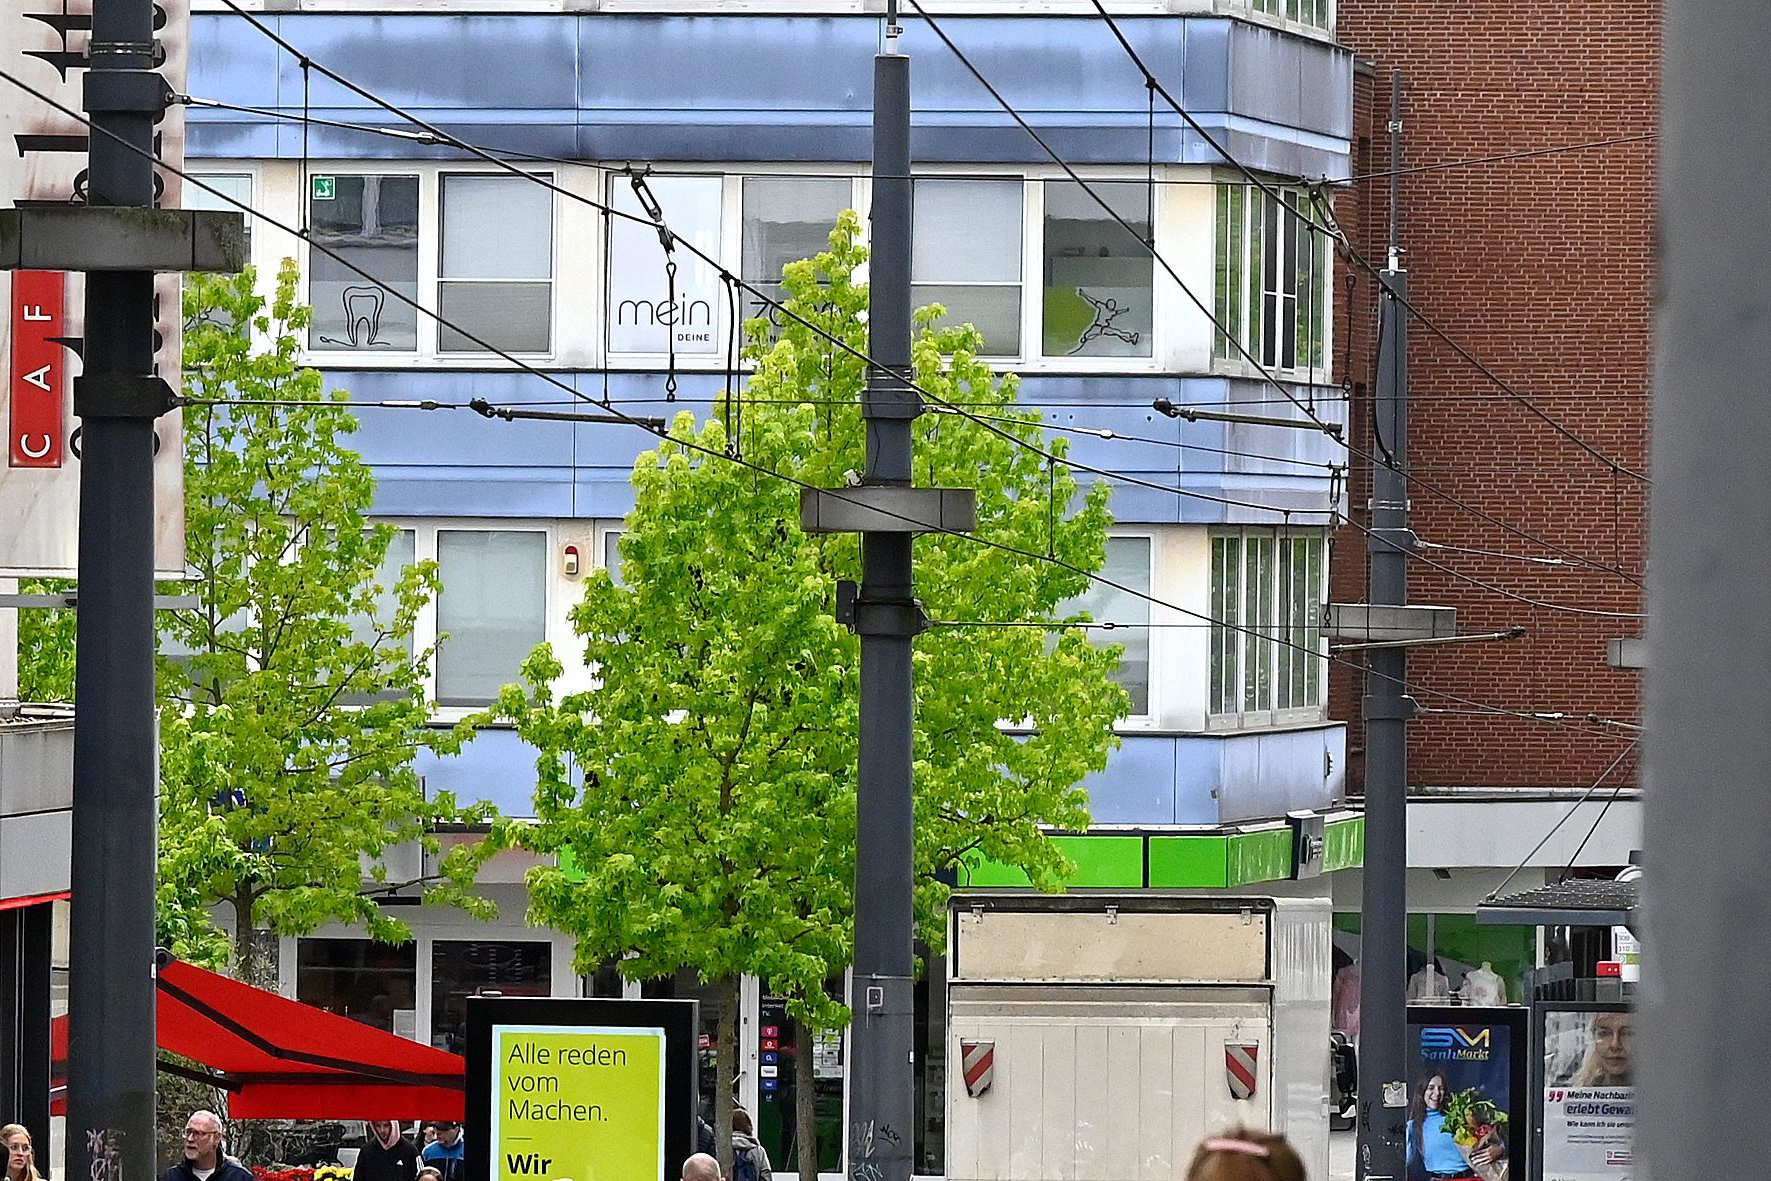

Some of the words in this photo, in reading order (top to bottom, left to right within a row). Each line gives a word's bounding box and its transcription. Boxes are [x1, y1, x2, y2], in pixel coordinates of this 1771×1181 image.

[619, 292, 710, 325] mein
[677, 333, 710, 341] DEINE
[21, 303, 53, 458] CAF
[507, 1043, 550, 1065] Alle
[558, 1044, 627, 1066] reden
[508, 1074, 559, 1093] vom
[1566, 1090, 1592, 1100] Meine
[508, 1099, 609, 1122] Machen.
[1566, 1103, 1601, 1115] erlebt
[1601, 1104, 1631, 1115] Gewa
[507, 1153, 553, 1175] Wir
